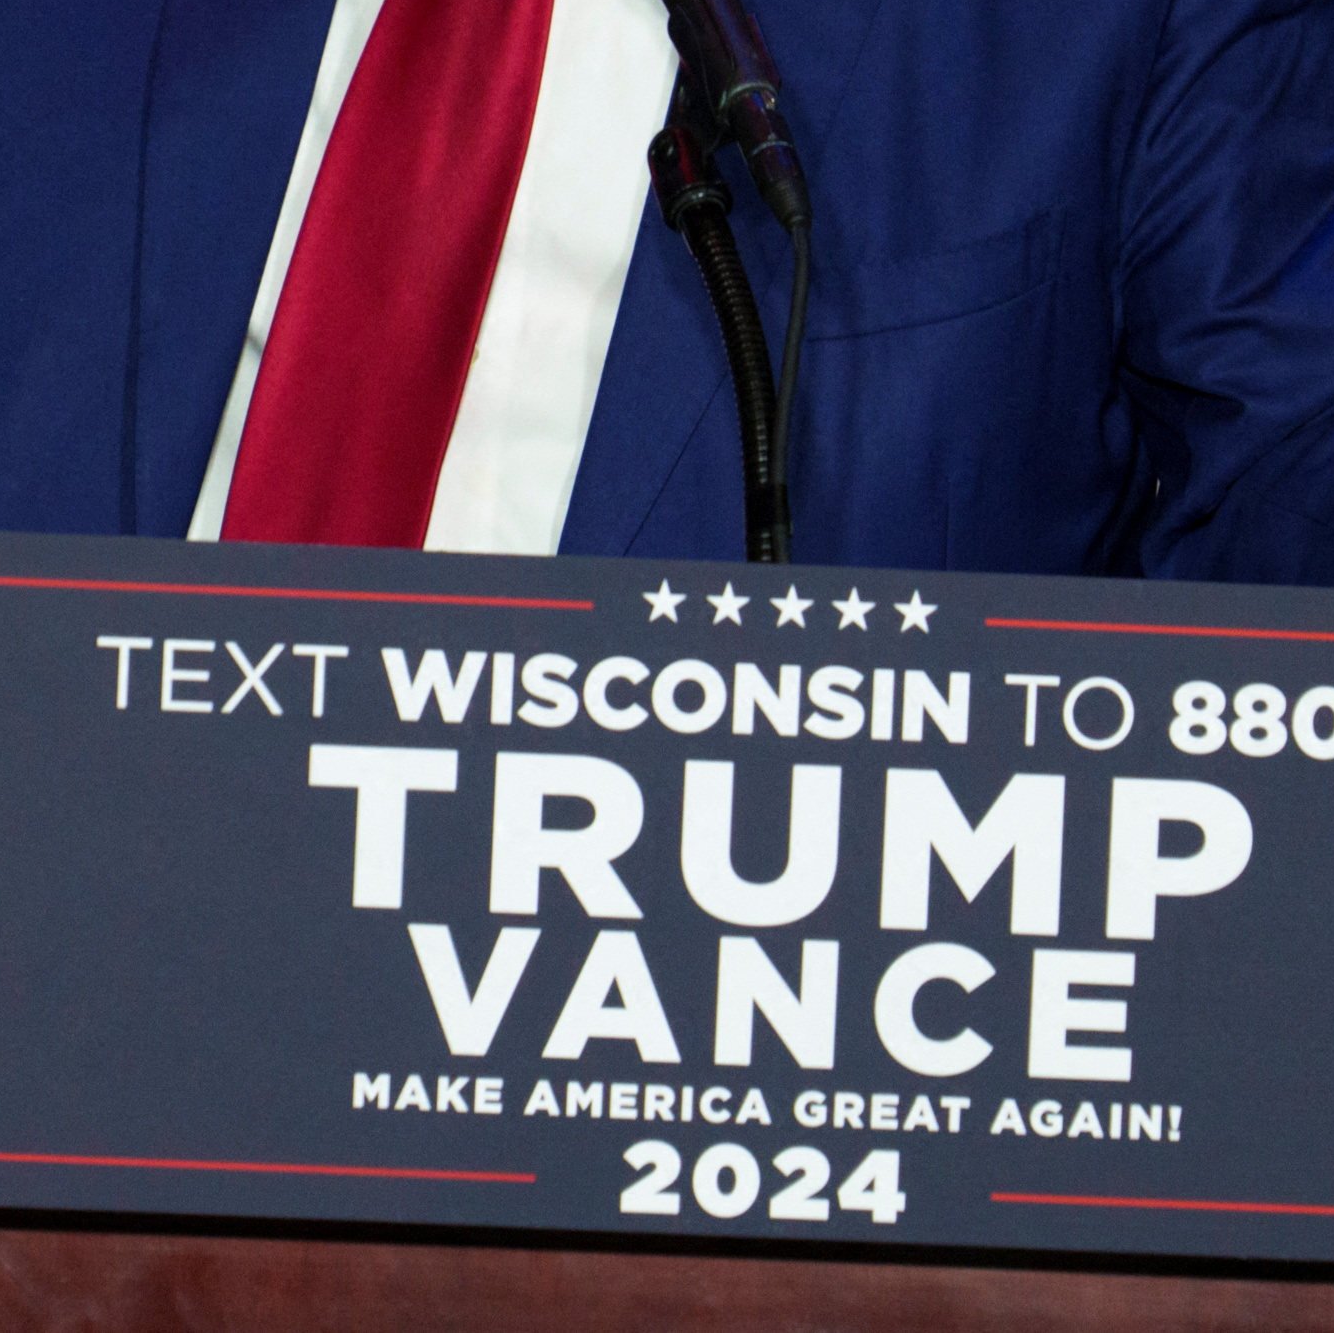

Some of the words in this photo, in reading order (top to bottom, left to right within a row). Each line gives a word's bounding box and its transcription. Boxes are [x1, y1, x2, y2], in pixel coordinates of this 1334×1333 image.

[96, 635, 350, 718] TEXT
[380, 647, 971, 744] WISCONSIN
[1004, 673, 1135, 751] TO
[308, 743, 1255, 941] TRUMP
[407, 923, 1136, 1083] VANCE
[352, 1072, 504, 1115] MAKE
[523, 1079, 772, 1126] AMERICA
[793, 1089, 971, 1133] GREAT
[990, 1098, 1182, 1142] AGAIN!
[619, 1139, 907, 1224] 2024
